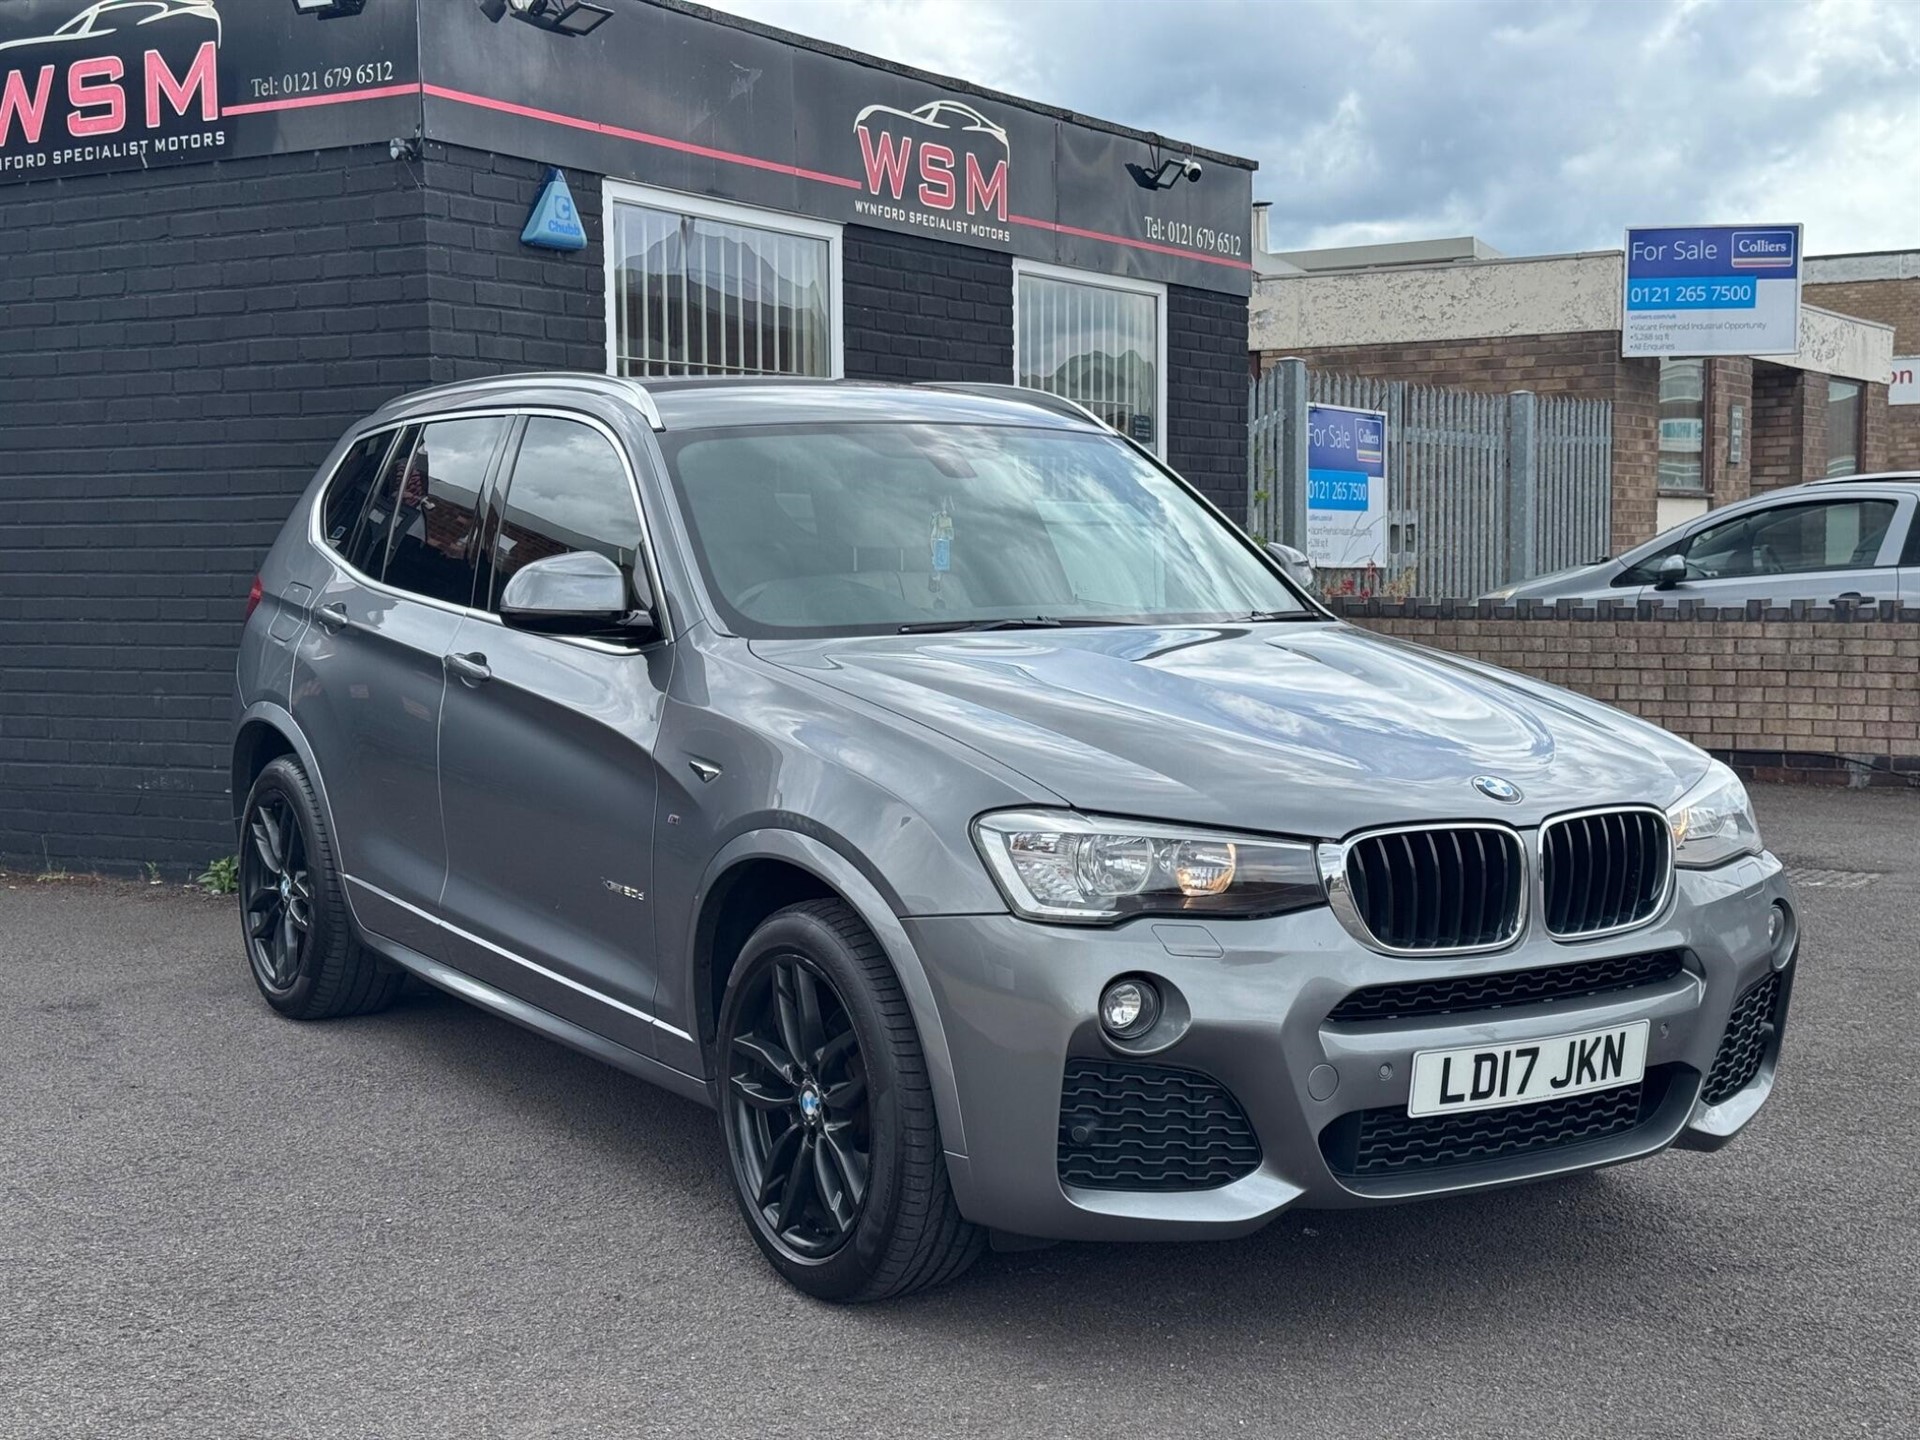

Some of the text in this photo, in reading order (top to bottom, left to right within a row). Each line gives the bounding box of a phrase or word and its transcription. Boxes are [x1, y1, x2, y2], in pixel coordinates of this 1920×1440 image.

[250, 61, 394, 97] Tel: 0121 679 6512
[0, 131, 225, 170] FORD SPECIALIST MOTORS
[857, 125, 1008, 222] WSM
[548, 219, 580, 236] Chubb
[854, 200, 1011, 242] WYNFORD SPECIALIST MOTORS
[1144, 216, 1242, 256] Tel: 0121 679 6512
[1738, 239, 1787, 253] Colliers
[1632, 240, 1718, 261] For Sale
[1631, 285, 1751, 303] 0121 265 7500
[1723, 321, 1767, 331] Opportunity
[1308, 422, 1351, 450] For Sale
[1358, 427, 1379, 445] Colliers
[1308, 480, 1367, 502] 0121 265 7500
[1439, 1031, 1627, 1106] LD17 JKN
